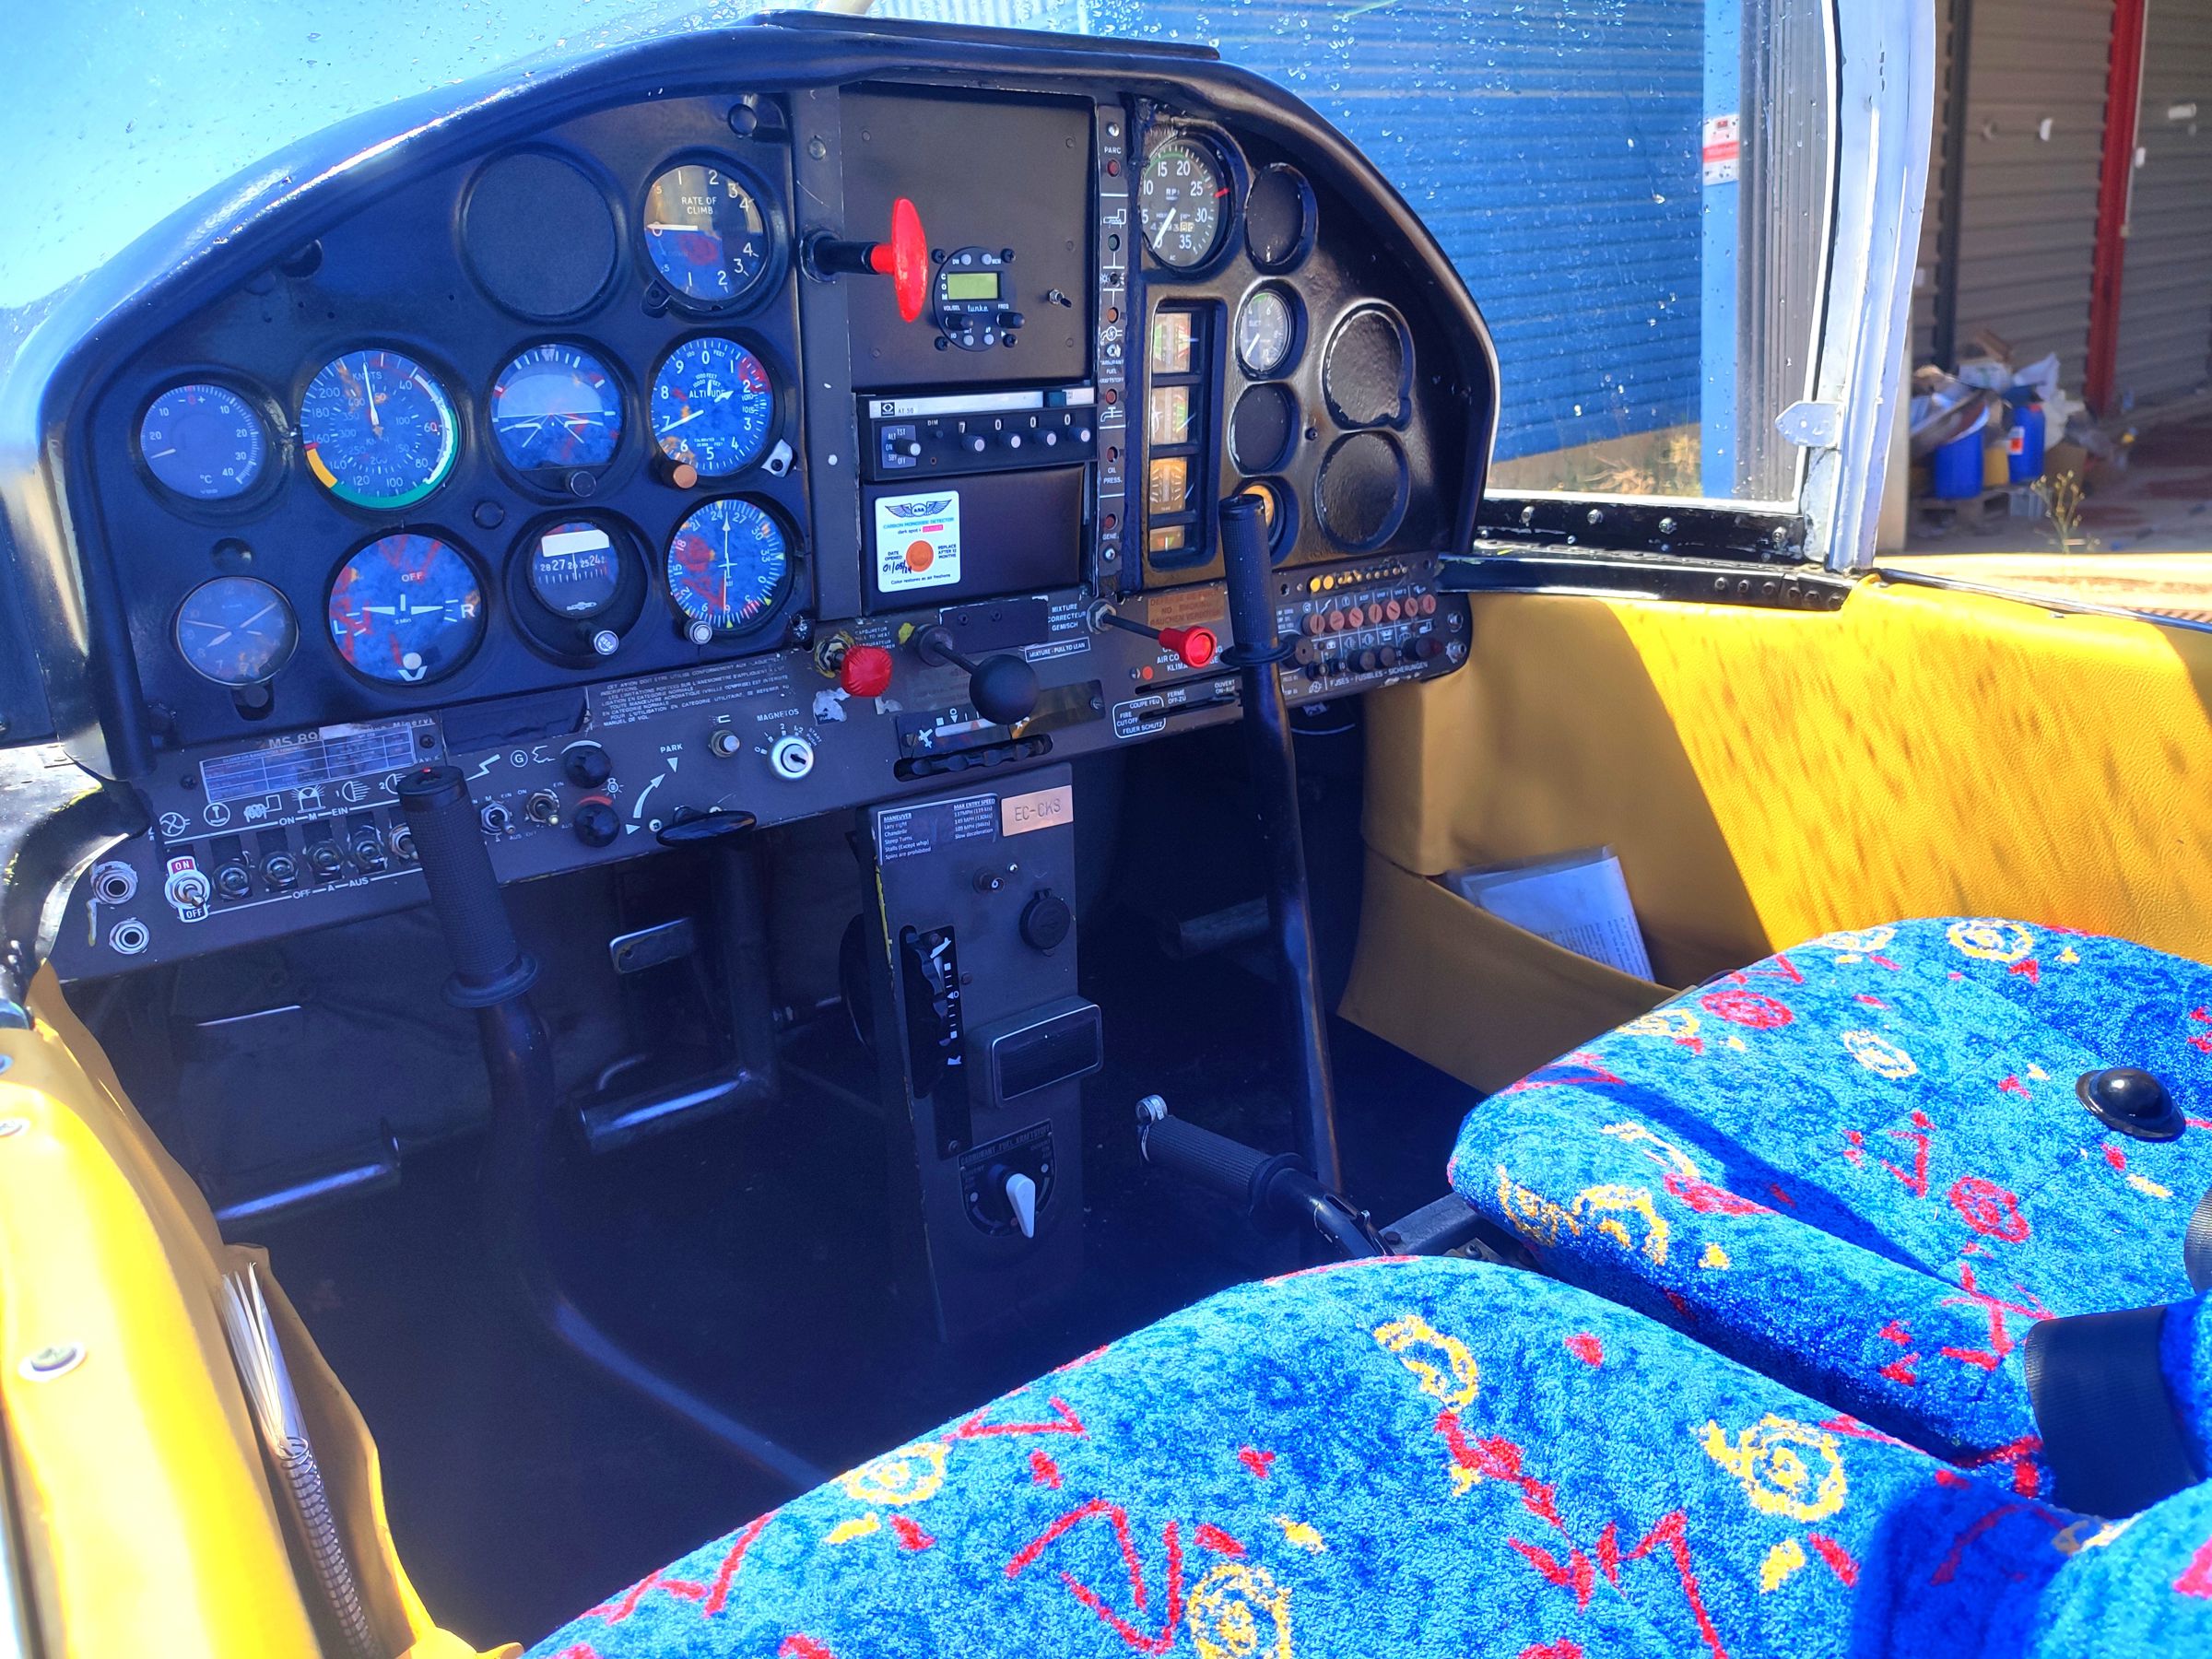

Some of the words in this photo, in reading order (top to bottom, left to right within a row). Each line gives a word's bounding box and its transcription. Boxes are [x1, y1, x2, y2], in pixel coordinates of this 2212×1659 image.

[1104, 146, 1122, 155] PARC
[1158, 162, 1167, 177] 15
[1177, 160, 1190, 176] 20
[709, 170, 719, 185] 2
[728, 183, 739, 198] 3
[1143, 180, 1153, 195] 10
[1190, 181, 1203, 196] 25
[682, 197, 704, 205] RATE
[706, 197, 717, 205] OF
[739, 198, 749, 211] 4
[1142, 209, 1149, 224] 5
[1195, 207, 1207, 223] 30
[1179, 235, 1192, 249] 35
[743, 242, 753, 257] 4
[733, 258, 744, 273] 3
[718, 271, 728, 285] 2
[701, 351, 710, 365] 0
[676, 360, 684, 374] 9
[399, 380, 412, 390] 40
[742, 380, 751, 393] 2
[319, 388, 341, 398] 200
[661, 386, 669, 400] 8
[159, 407, 169, 416] 10
[220, 406, 230, 414] 10
[312, 408, 329, 418] 180
[424, 422, 437, 432] 60
[744, 418, 752, 431] 3
[959, 422, 966, 434] 7
[995, 419, 1002, 430] 0
[1030, 416, 1037, 428] 0
[1064, 414, 1071, 425] 0
[149, 431, 162, 440] 20
[236, 429, 247, 437] 20
[312, 434, 330, 443] 160
[339, 429, 356, 437] 300
[681, 439, 688, 452] 6
[731, 436, 739, 449] 4
[235, 452, 247, 460] 30
[706, 447, 714, 460] 5
[330, 460, 347, 470] 140
[415, 458, 429, 468] 80
[222, 467, 234, 476] 40
[200, 475, 213, 483] °C
[353, 475, 370, 485] 120
[387, 478, 403, 487] 100
[711, 511, 723, 521] 24
[732, 512, 747, 524] 27
[690, 520, 700, 531] 21
[752, 528, 764, 541] 30
[675, 539, 686, 551] 18
[761, 549, 771, 563] 33
[552, 559, 565, 571] 27
[580, 559, 589, 568] 25
[672, 564, 682, 576] 15
[401, 572, 424, 582] OFF
[758, 576, 767, 584] 0
[681, 586, 693, 600] 12
[461, 604, 475, 619] R
[1052, 603, 1078, 613] MIXTURE
[333, 620, 347, 635] L
[1052, 621, 1078, 632] GEMISCH
[1029, 648, 1050, 658] MIXTURE
[1157, 655, 1168, 664] AIR
[1330, 676, 1349, 686] FUSES
[1355, 670, 1383, 681] FUSIBLES
[1388, 661, 1428, 675] SICHERUNGEN
[1214, 679, 1235, 688] OUVERT
[1130, 700, 1148, 709] COUPE
[757, 709, 800, 722] MAGNETOS
[1123, 725, 1141, 734] FEUER
[1141, 721, 1163, 731] SCHUTZ
[269, 736, 293, 749] MS
[660, 743, 683, 753] PARK
[965, 801, 981, 810] ENTRY
[981, 798, 996, 807] SPEED
[331, 807, 348, 817] EIN
[1015, 798, 1062, 822] EC-CKS
[279, 817, 295, 826] ON
[308, 813, 318, 821] M
[175, 860, 190, 871] ON
[328, 883, 335, 892] A
[349, 877, 369, 888] AUS
[293, 890, 311, 900] OFF
[186, 908, 202, 918] OFF
